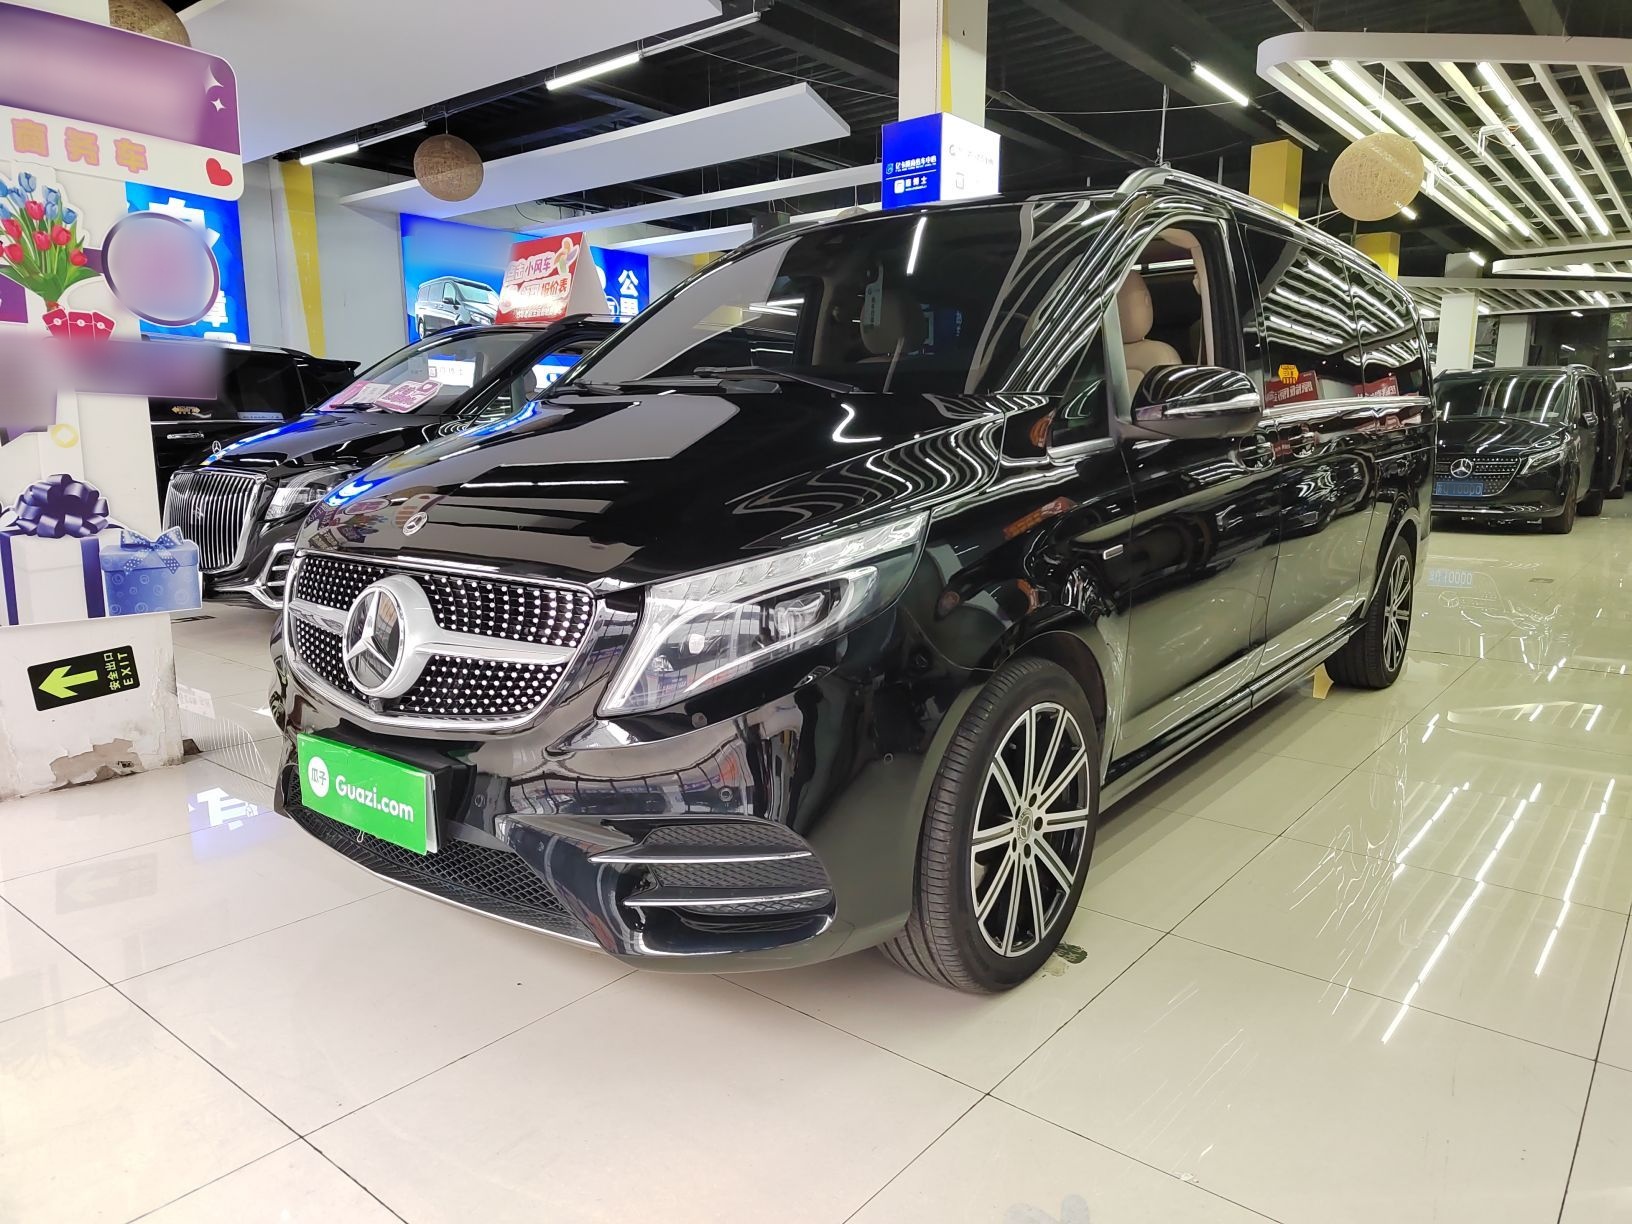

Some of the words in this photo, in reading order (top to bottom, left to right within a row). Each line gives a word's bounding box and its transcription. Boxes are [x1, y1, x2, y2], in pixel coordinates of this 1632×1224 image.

[103, 652, 121, 691] 安全出口
[117, 652, 134, 686] EXIT
[310, 767, 328, 786] 瓜子
[335, 774, 414, 822] Guazi.com
